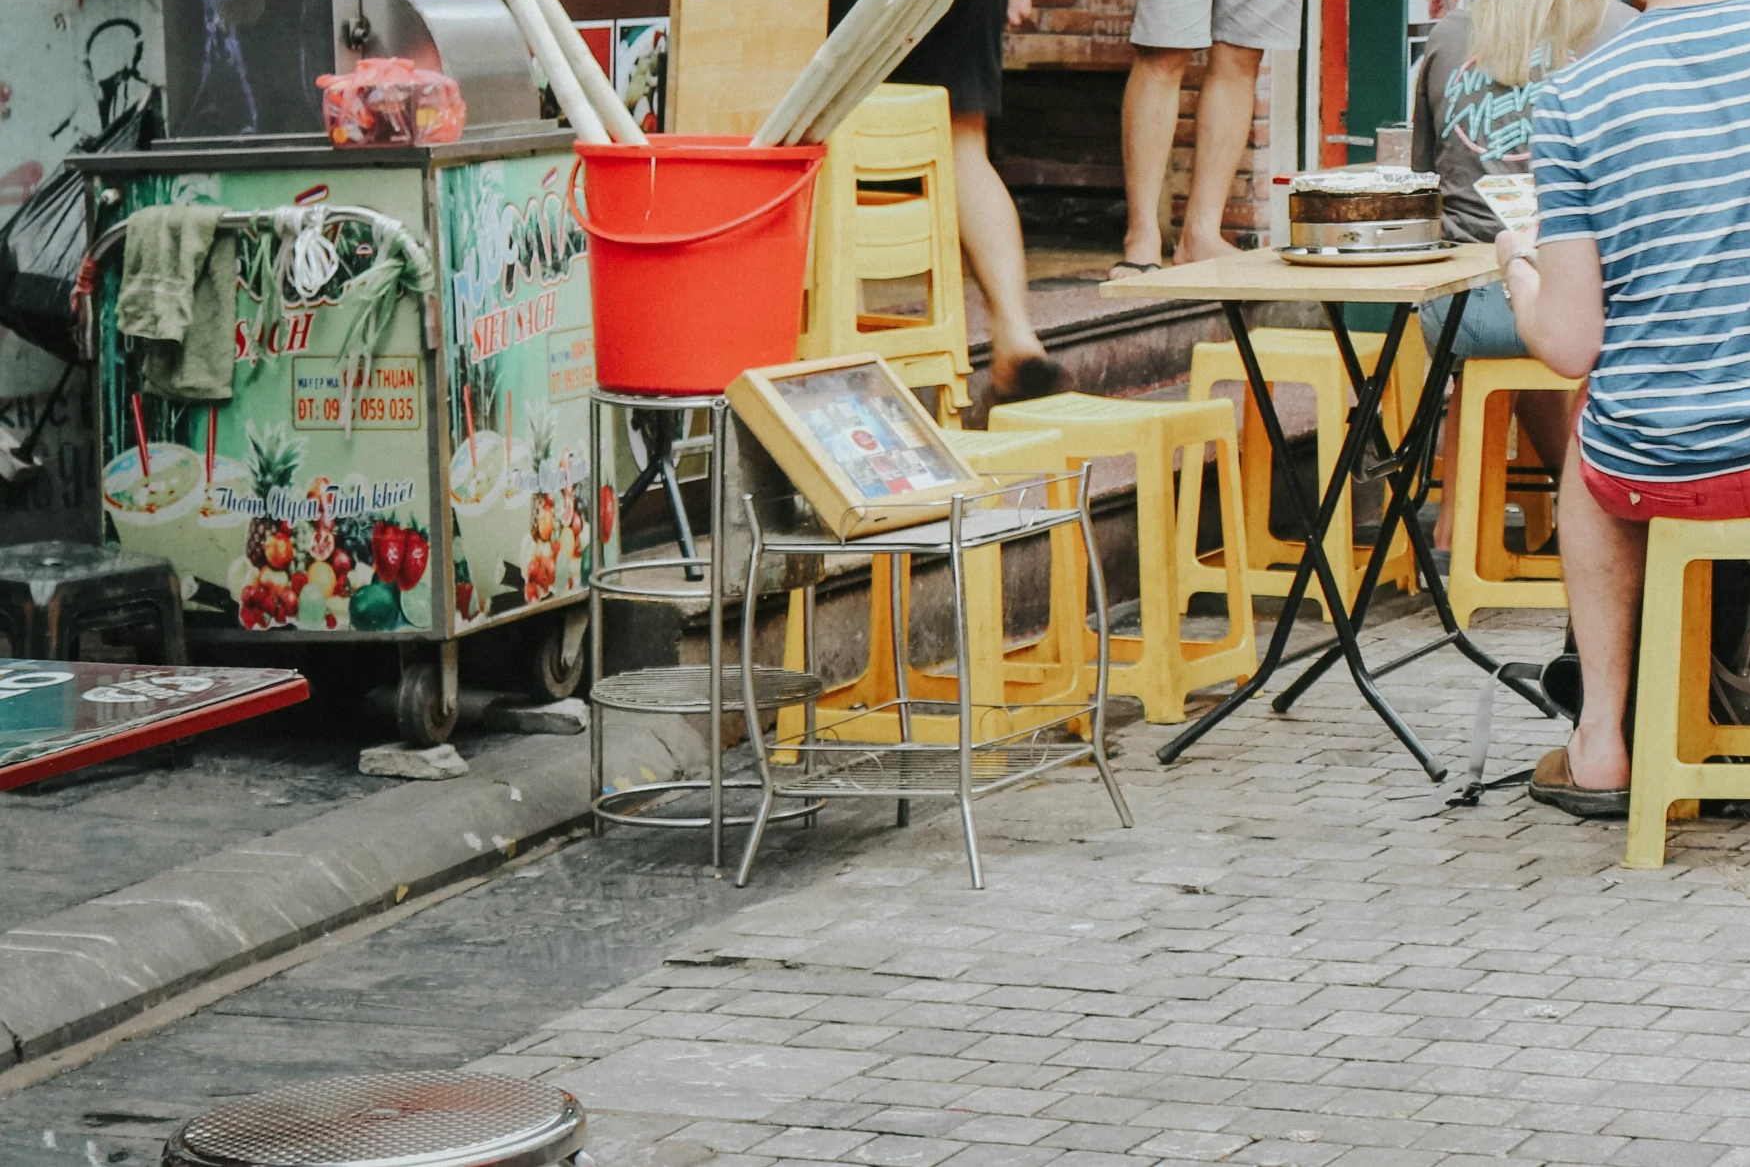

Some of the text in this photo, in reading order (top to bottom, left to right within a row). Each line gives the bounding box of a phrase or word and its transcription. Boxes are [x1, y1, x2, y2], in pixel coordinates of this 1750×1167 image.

[235, 312, 316, 367] SCH
[515, 290, 557, 347] SẠCH
[324, 398, 357, 421] 09
[361, 398, 384, 421] 059
[390, 398, 413, 420] 035
[215, 487, 264, 514] Thơm
[267, 486, 319, 525] Ngon
[372, 480, 415, 510] khiết
